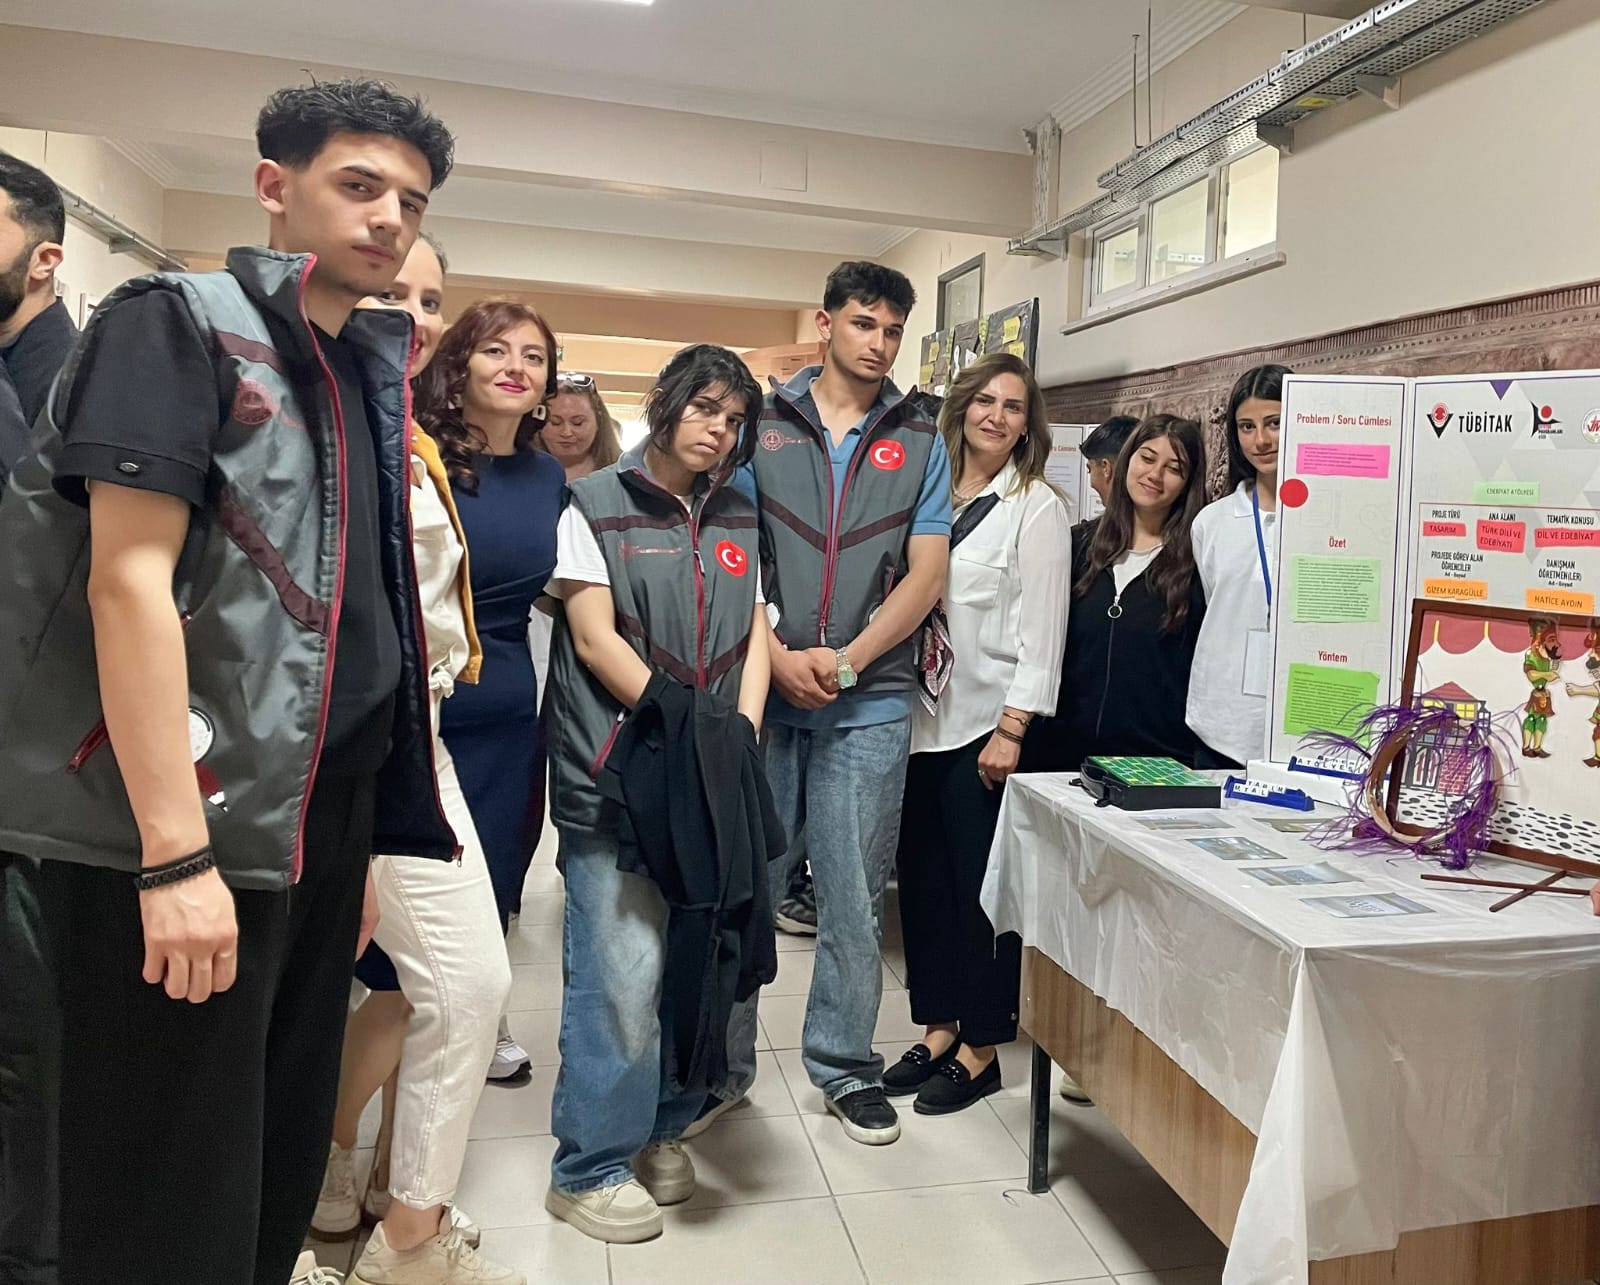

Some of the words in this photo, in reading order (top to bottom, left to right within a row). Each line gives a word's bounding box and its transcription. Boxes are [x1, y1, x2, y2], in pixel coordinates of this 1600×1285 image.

[1296, 413, 1330, 424] Problem
[1332, 414, 1336, 424] /
[1338, 414, 1356, 426] Soru
[1358, 416, 1392, 426] Cümlesi
[1459, 412, 1512, 432] TÜBİTAK
[1432, 510, 1447, 518] PROJE
[1448, 510, 1461, 518] TÜRÜ
[1547, 514, 1569, 524] TEMATİK
[1571, 516, 1594, 525] KONUSU
[1430, 525, 1456, 534] TASARIM
[1482, 526, 1497, 535] TÜRK
[1500, 528, 1512, 537] DİLİ
[1538, 530, 1548, 539] DİL
[1560, 530, 1594, 540] EDEBİYAT
[1328, 536, 1346, 548] Özet
[1480, 537, 1512, 550] EDEBİYATI
[1431, 550, 1452, 560] PROJEDE
[1453, 550, 1468, 561] GÖREV
[1470, 554, 1483, 562] ALAN
[1546, 559, 1576, 570] DANIŞMAN
[1426, 586, 1446, 594] GİZEM
[1448, 588, 1484, 597] KARAGÜLLE
[1535, 595, 1559, 605] HATİCE
[1560, 599, 1583, 608] AYDIN
[1318, 650, 1348, 663] Yöntem
